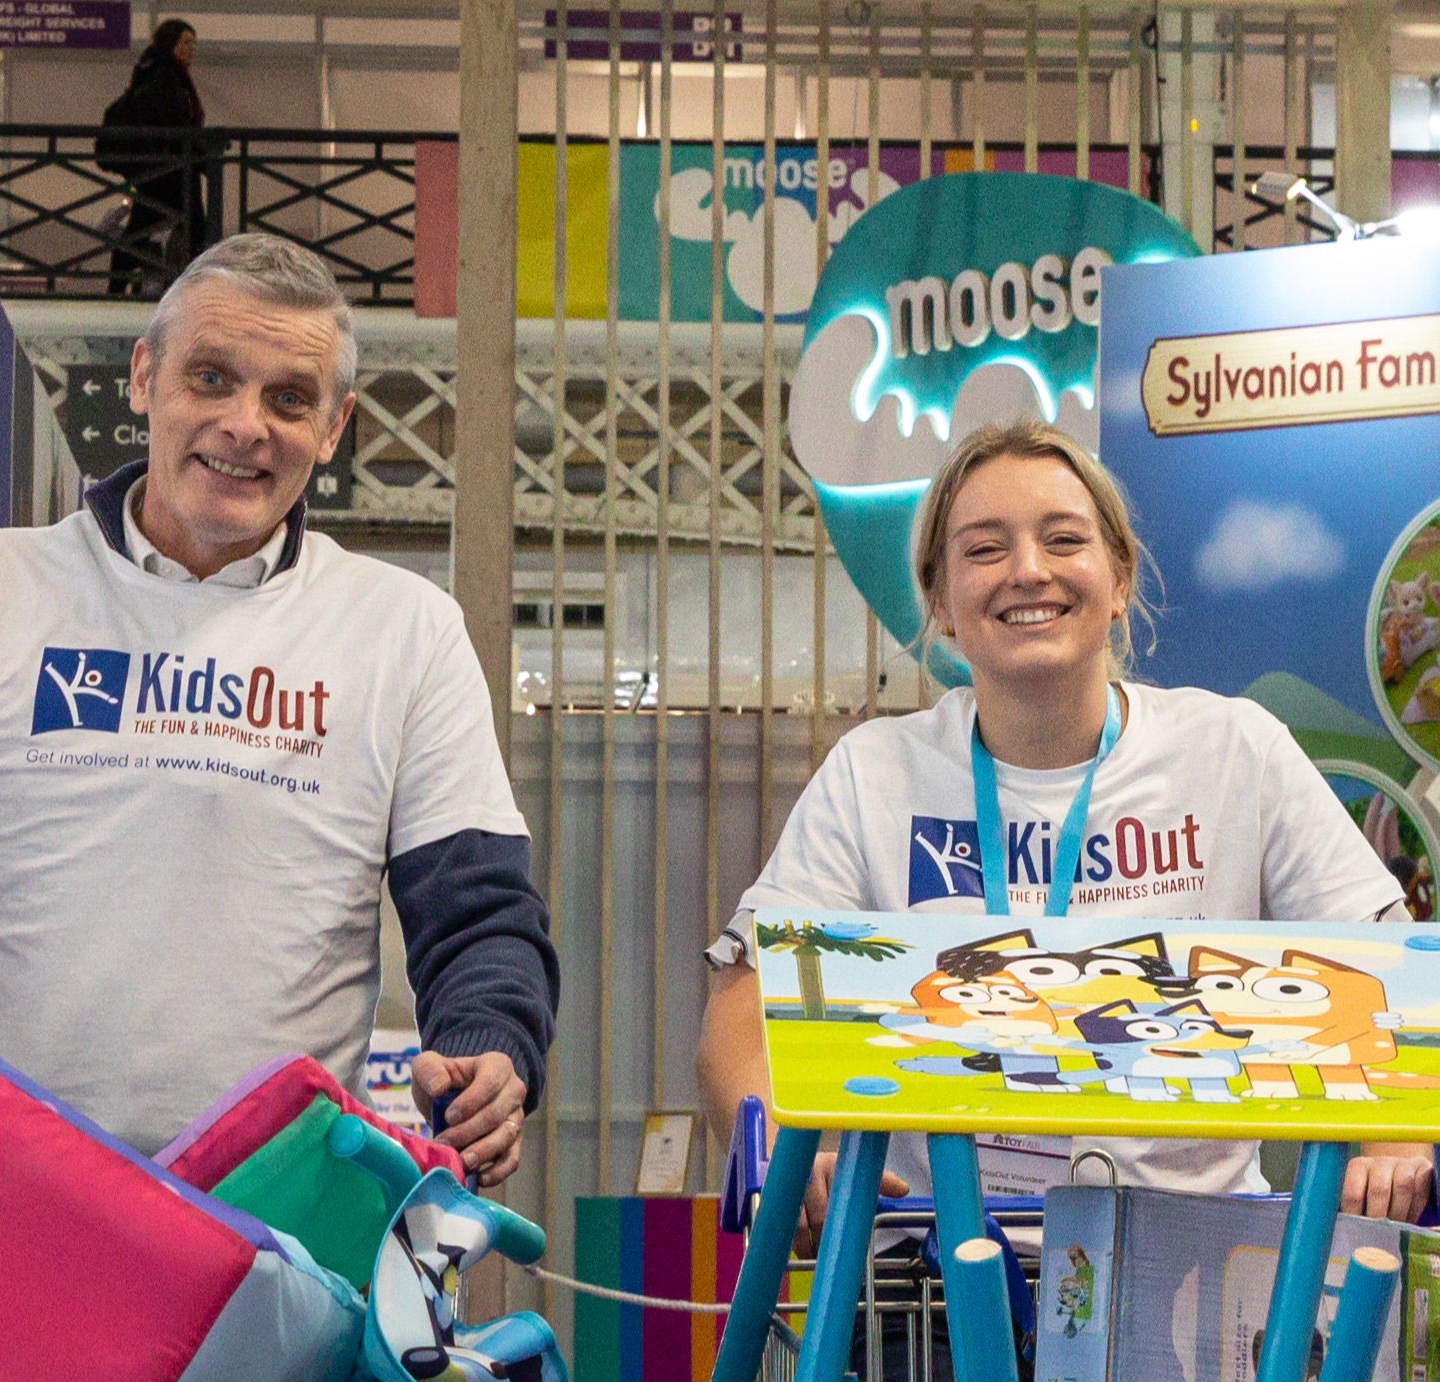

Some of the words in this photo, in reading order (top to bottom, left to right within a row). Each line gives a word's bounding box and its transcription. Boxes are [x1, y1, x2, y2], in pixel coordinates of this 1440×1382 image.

[1165, 351, 1345, 419] Sylvanian
[136, 652, 330, 738] KidsOut
[134, 720, 156, 735] THE
[161, 719, 186, 735] FUN
[190, 720, 200, 736] &
[205, 721, 271, 749] HAPPINESS
[275, 735, 325, 759] CHARITY
[26, 749, 56, 764] Get
[59, 752, 129, 768] involved
[134, 755, 150, 769] at
[156, 757, 321, 795] www.kidsout.org.uk
[1009, 889, 1032, 904] THE
[1079, 882, 1149, 905] HAPPINESS
[1153, 875, 1206, 897] CHARITY
